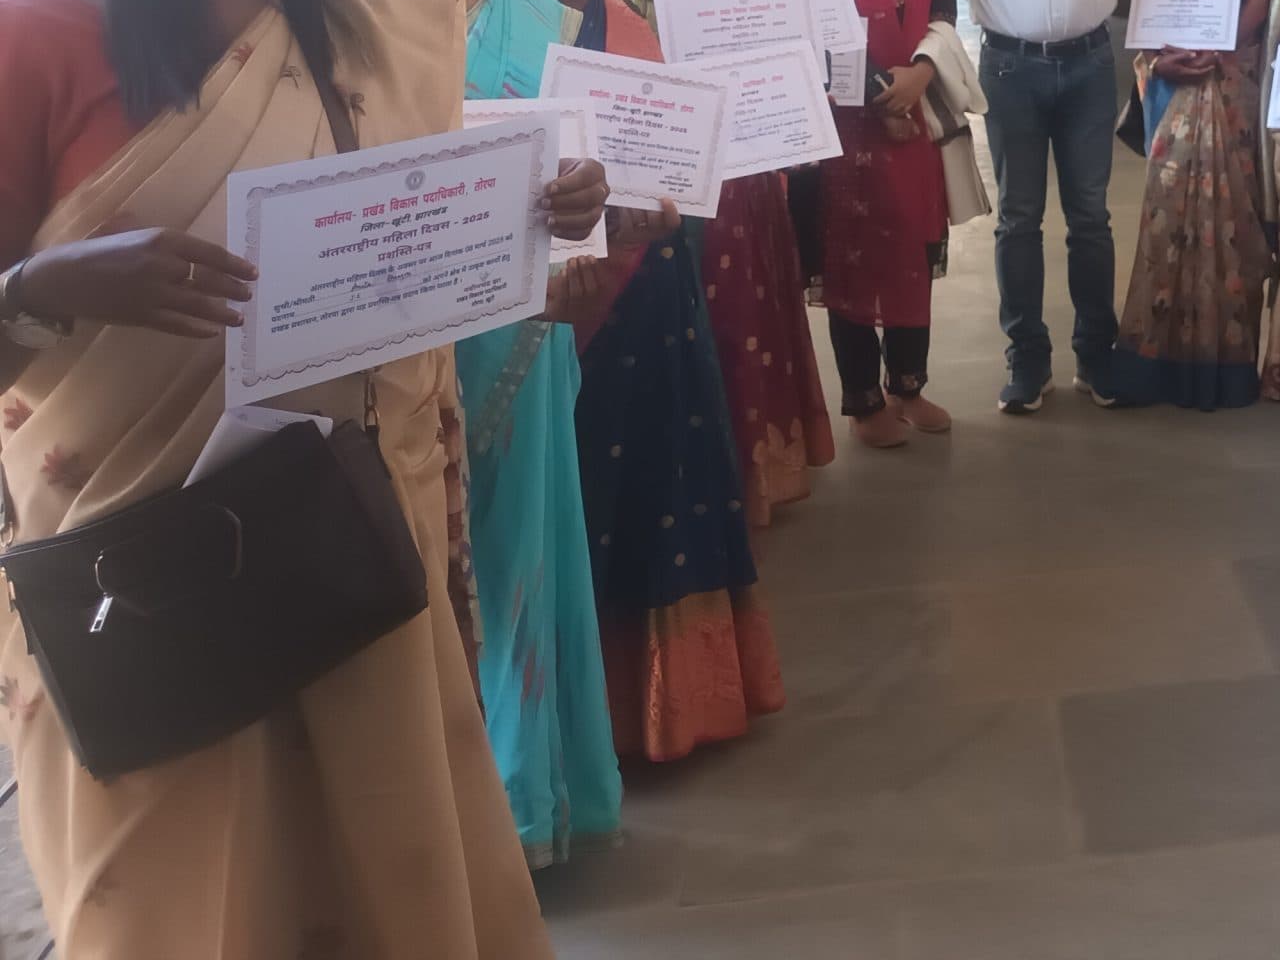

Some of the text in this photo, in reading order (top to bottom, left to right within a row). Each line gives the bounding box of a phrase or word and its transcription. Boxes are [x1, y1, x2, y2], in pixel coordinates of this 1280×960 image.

[390, 196, 418, 214] विकास
[474, 177, 496, 192] तोरपा
[318, 238, 379, 259] अंतरराष्ट्रीय
[383, 228, 418, 244] महिला
[421, 221, 450, 236] दिवस
[462, 211, 490, 225] 2025
